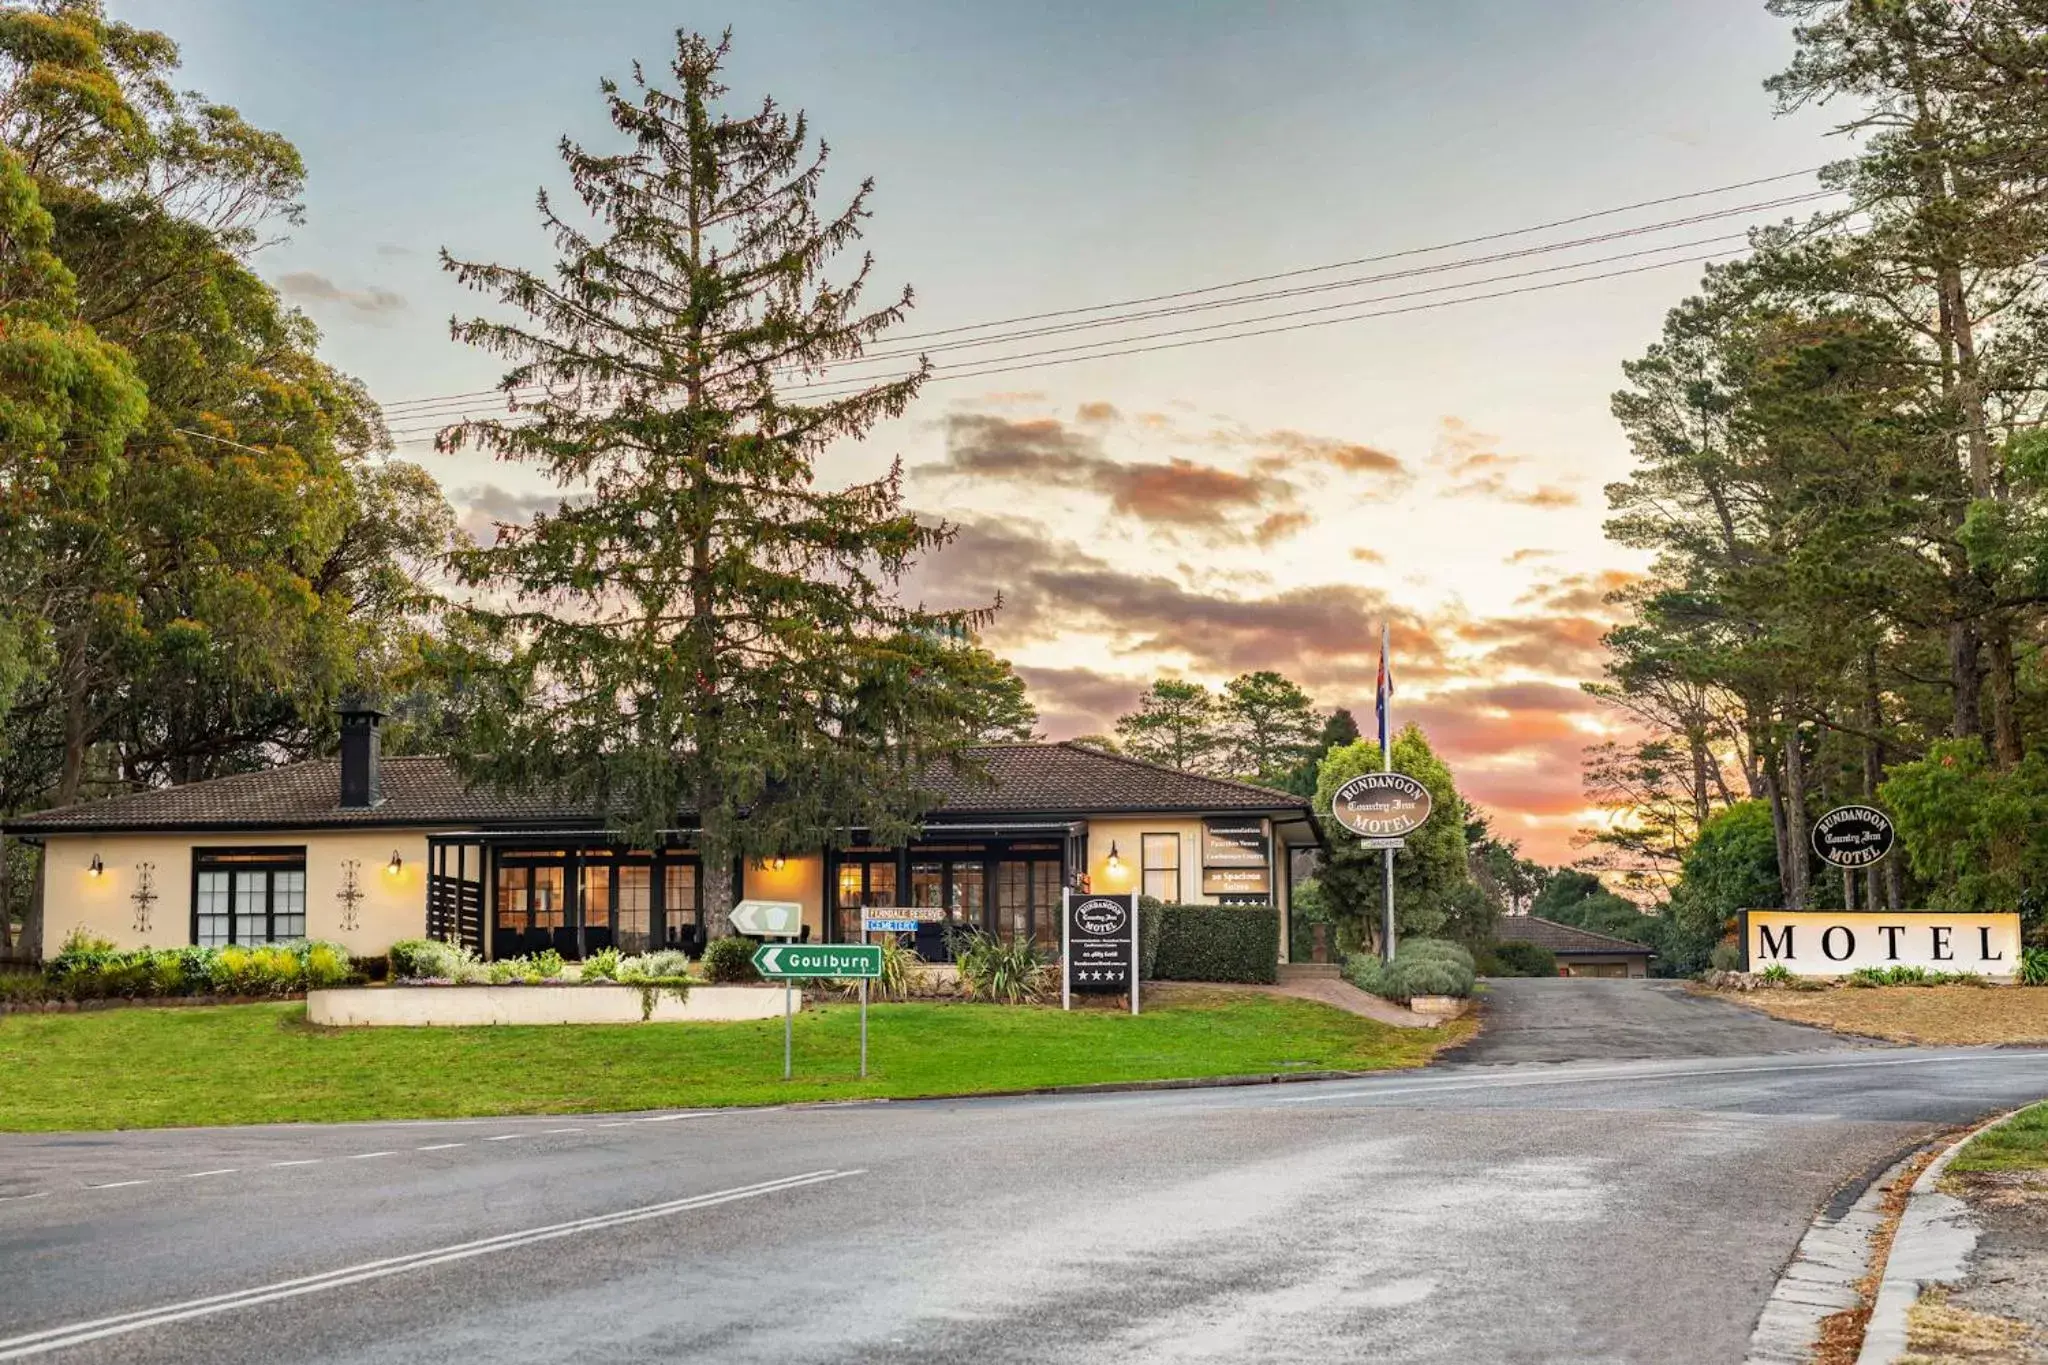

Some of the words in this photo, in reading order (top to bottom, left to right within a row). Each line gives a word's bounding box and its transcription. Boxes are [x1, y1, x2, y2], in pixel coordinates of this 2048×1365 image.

[1341, 776, 1424, 801] BUNDANOON
[1347, 801, 1390, 813] Country
[1392, 799, 1416, 810] Inn
[1352, 814, 1415, 833] MOTEL
[1818, 809, 1888, 834] BUNDANOON
[1824, 833, 1860, 844] Country
[1861, 830, 1881, 844] Inn
[1828, 845, 1881, 864] MOTEL
[869, 920, 918, 930] CEMETERY
[1085, 921, 1118, 932] MOTEL
[1758, 925, 2003, 961] MOTEL
[789, 954, 870, 968] Goulburn
